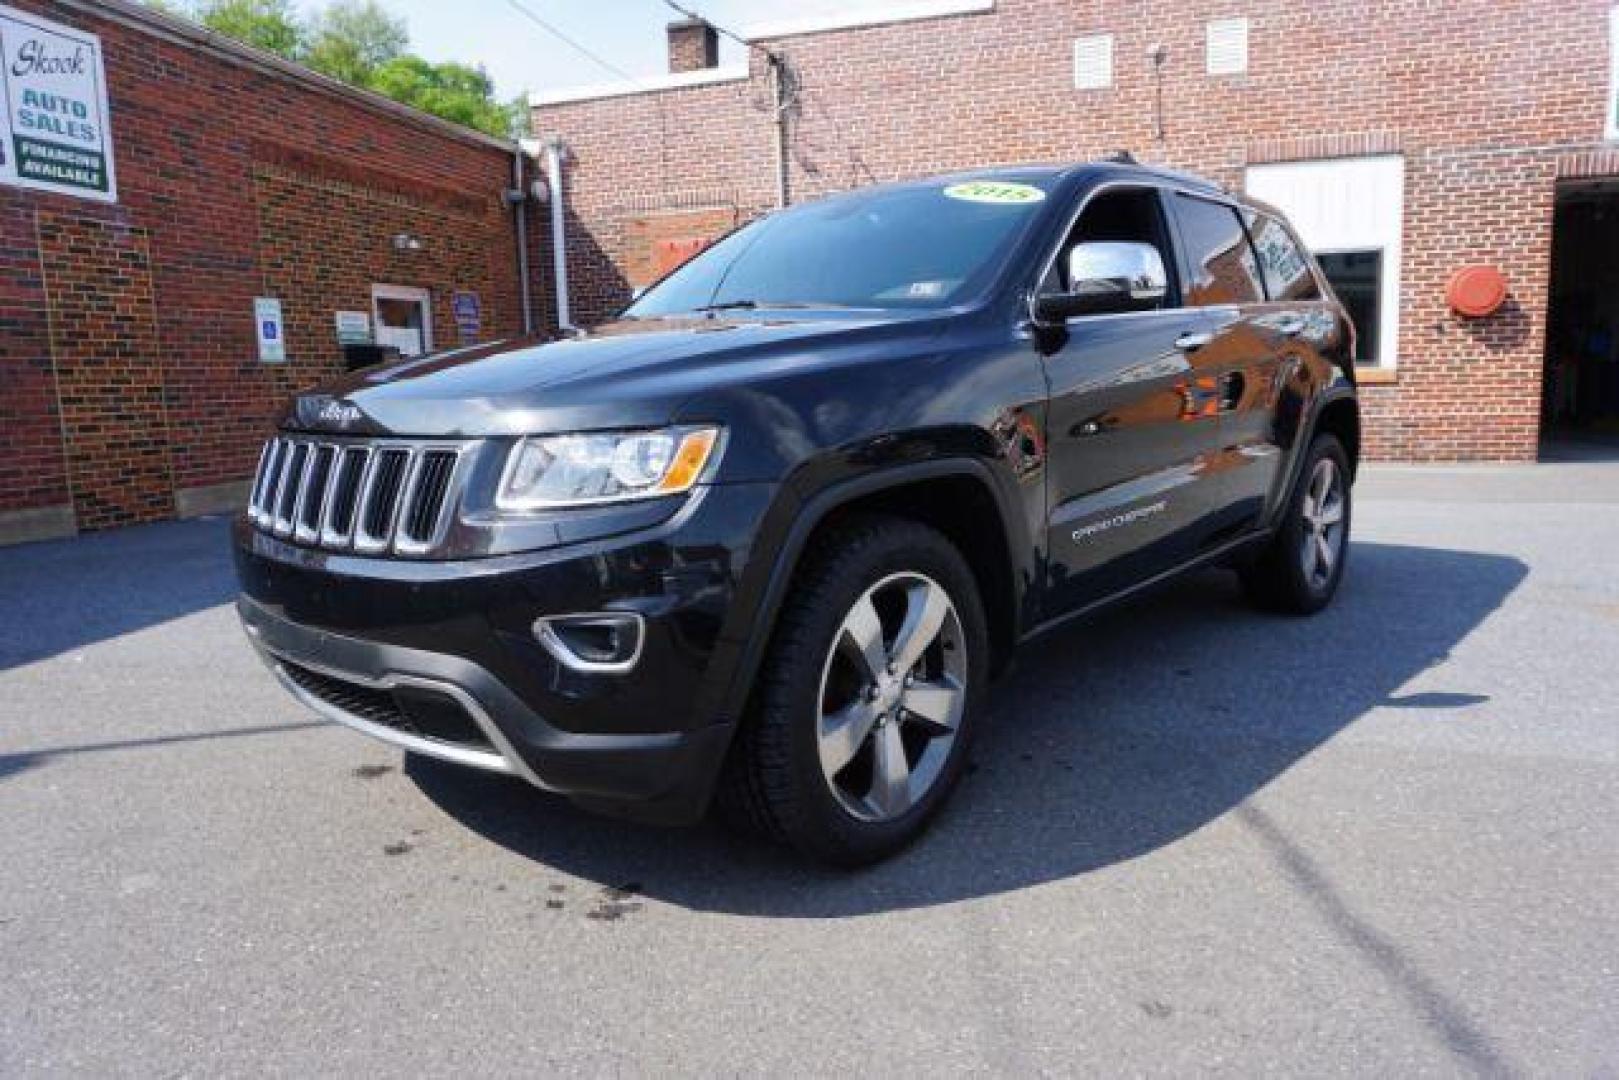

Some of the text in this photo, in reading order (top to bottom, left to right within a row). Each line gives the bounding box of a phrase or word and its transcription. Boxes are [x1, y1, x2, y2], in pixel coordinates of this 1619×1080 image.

[12, 40, 85, 76] Skook
[22, 87, 87, 120] AUTO
[18, 108, 96, 142] SALES
